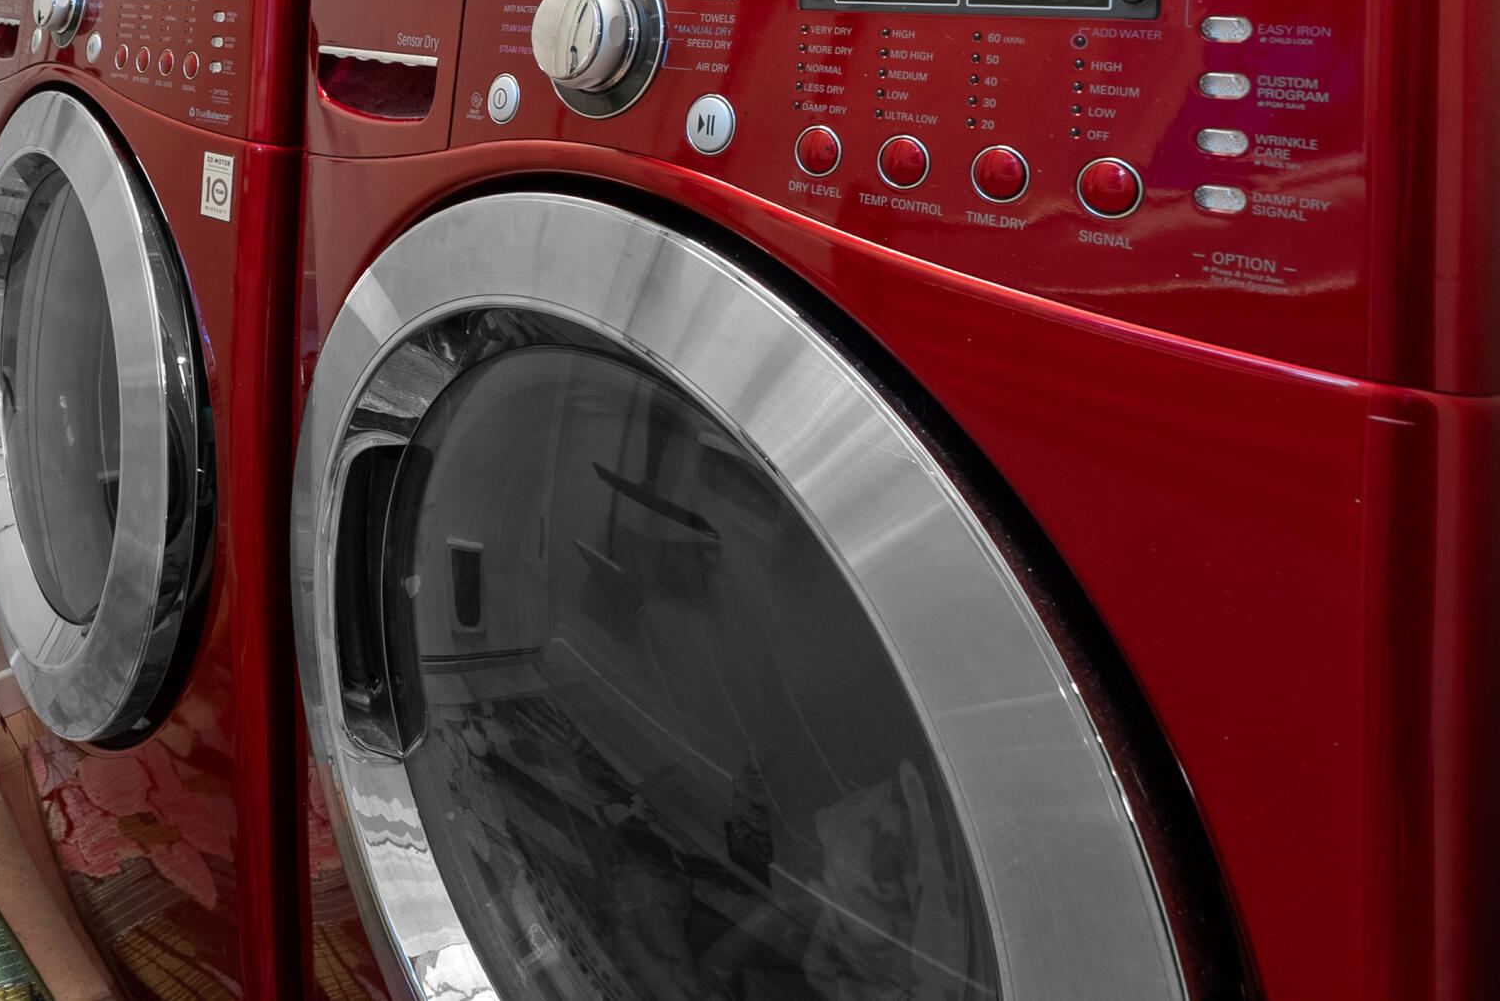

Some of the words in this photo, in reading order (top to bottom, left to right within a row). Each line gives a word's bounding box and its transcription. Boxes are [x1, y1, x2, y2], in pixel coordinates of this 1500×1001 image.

[700, 13, 736, 24] TOWELS
[715, 26, 732, 36] DRY
[811, 25, 832, 35] VERY
[834, 26, 852, 36] DRY
[892, 29, 916, 39] HIGH
[1091, 27, 1117, 39] ADD
[1119, 29, 1163, 40] WATER
[1257, 23, 1293, 36] EASY
[1296, 25, 1333, 38] IRON
[396, 32, 423, 48] Sensor
[424, 34, 440, 52] Dry
[686, 38, 713, 49] SPEED
[714, 39, 732, 50] DRY
[987, 33, 1001, 44] 60
[807, 44, 833, 55] MORE
[834, 46, 853, 56] DRY
[890, 50, 908, 60] MID
[910, 51, 934, 62] HIGH
[985, 54, 999, 65] 50
[695, 61, 710, 71] AIR
[711, 62, 730, 73] DRY
[805, 64, 843, 75] NORMAL
[1090, 61, 1123, 72] HIGH
[888, 70, 928, 82] MEDIUM
[984, 76, 998, 87] 40
[1257, 75, 1319, 90] CUSTOM
[803, 83, 825, 93] LESS
[826, 84, 845, 95] DRY
[1089, 84, 1141, 98] MEDIUM
[1256, 87, 1329, 103] PROGRAM
[886, 90, 909, 101] LOW
[802, 102, 827, 114] DAMP
[829, 105, 847, 115] DRY
[982, 98, 996, 108] 30
[884, 110, 914, 123] ULTRA
[915, 113, 938, 125] LOW
[1088, 107, 1117, 119] LOW
[981, 119, 995, 130] 20
[1086, 130, 1110, 142] OFF
[1254, 133, 1319, 151] WRINKLE
[1253, 146, 1291, 160] CARE
[206, 176, 228, 207] 10
[788, 180, 809, 193] DRY
[811, 183, 842, 199] LEVEL
[859, 192, 889, 208] TEMP.
[890, 197, 944, 216] CONTROL
[1252, 192, 1297, 207] DAMP
[1299, 197, 1332, 212] DRY
[1252, 204, 1308, 222] SIGNAL
[966, 210, 997, 227] TIME
[999, 215, 1028, 231] DRY
[1078, 229, 1134, 250] SIGNAL
[1211, 251, 1277, 273] OPTION
